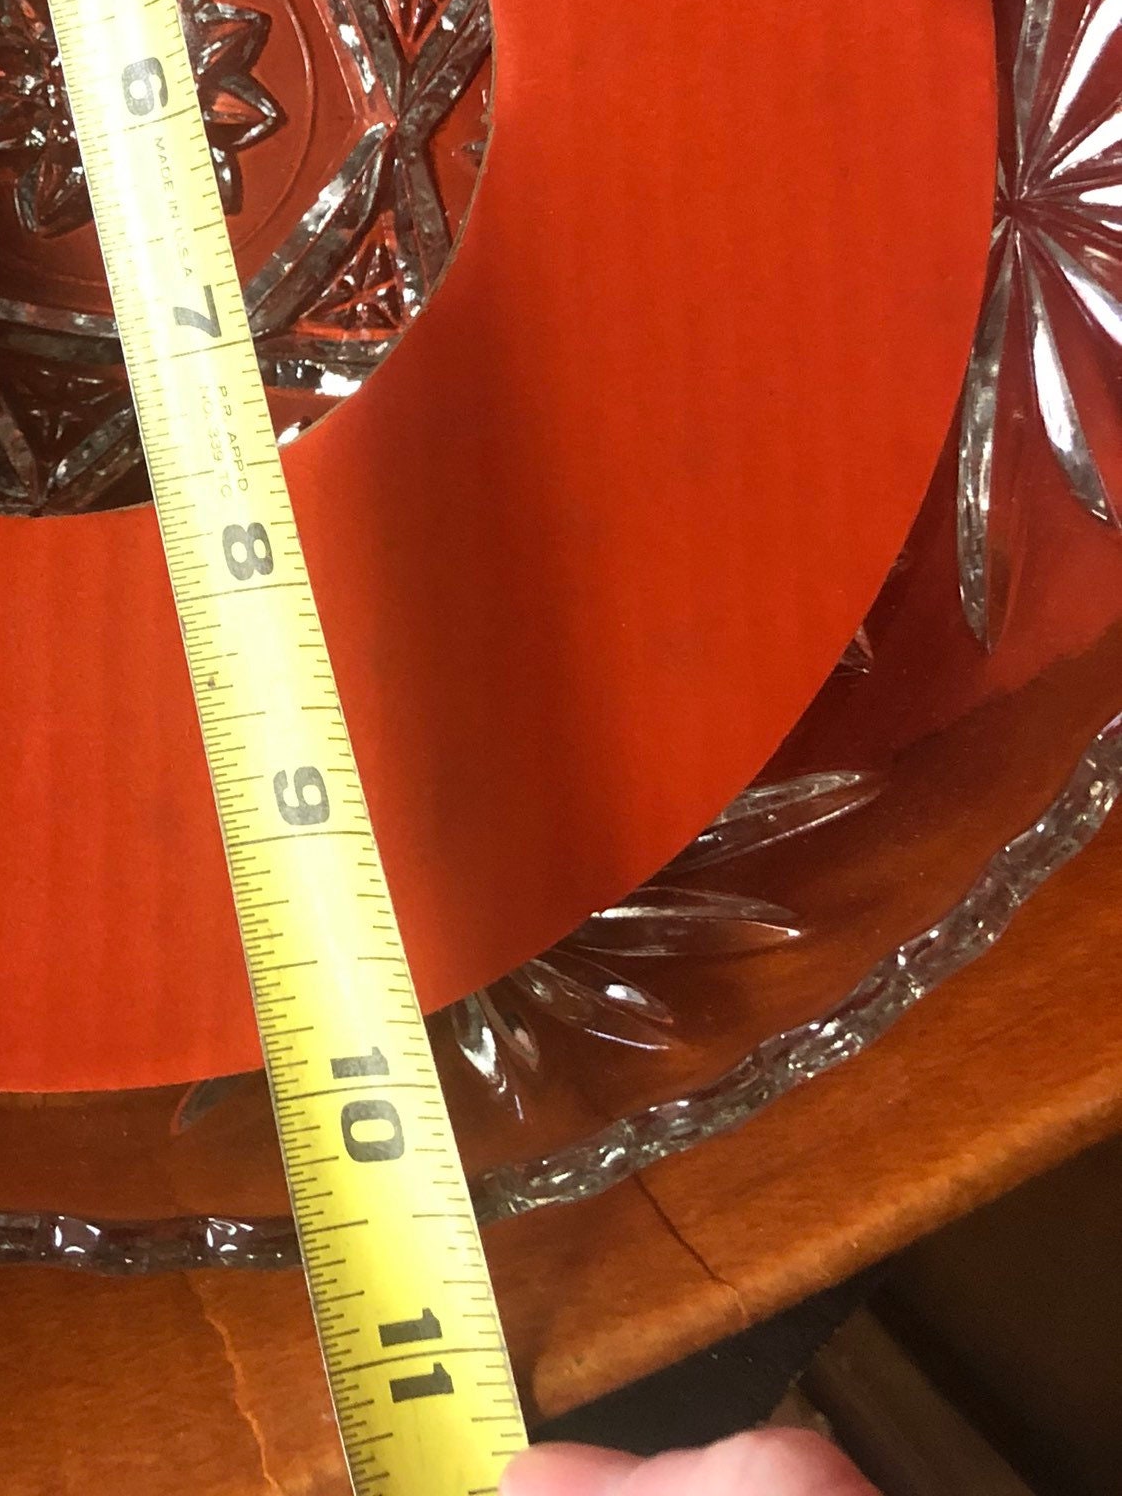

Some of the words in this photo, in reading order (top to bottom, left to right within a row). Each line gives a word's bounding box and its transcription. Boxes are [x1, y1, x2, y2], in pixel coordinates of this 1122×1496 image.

[122, 56, 169, 116] 6
[155, 136, 174, 191] MADE
[173, 284, 222, 339] 7
[222, 522, 274, 581] 8
[273, 765, 330, 826] 9
[330, 1045, 405, 1163] 10
[378, 1307, 455, 1403] 11
